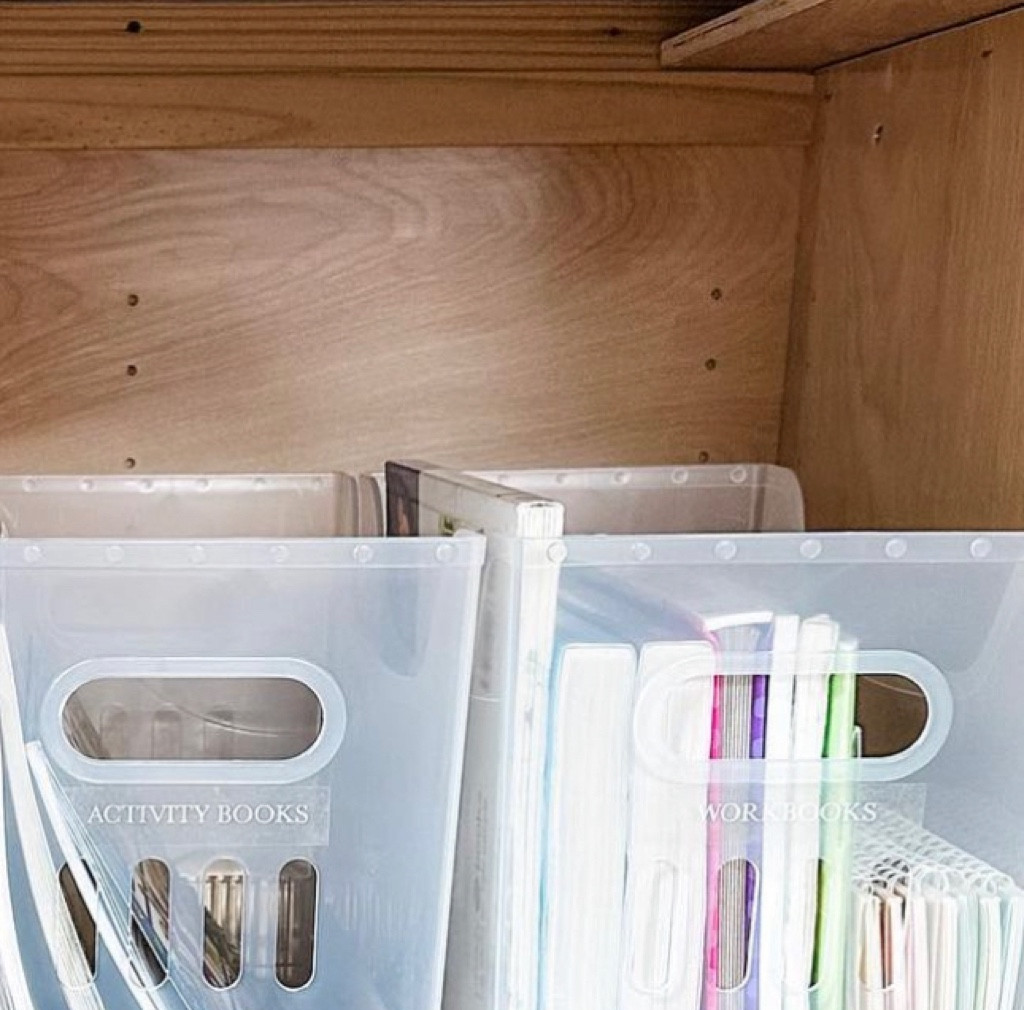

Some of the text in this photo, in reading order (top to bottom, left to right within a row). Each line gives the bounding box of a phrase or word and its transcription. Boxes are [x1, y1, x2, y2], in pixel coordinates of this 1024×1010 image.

[87, 804, 310, 824] ACTIVITY BOOKS
[698, 801, 878, 823] WORKBOOKS
